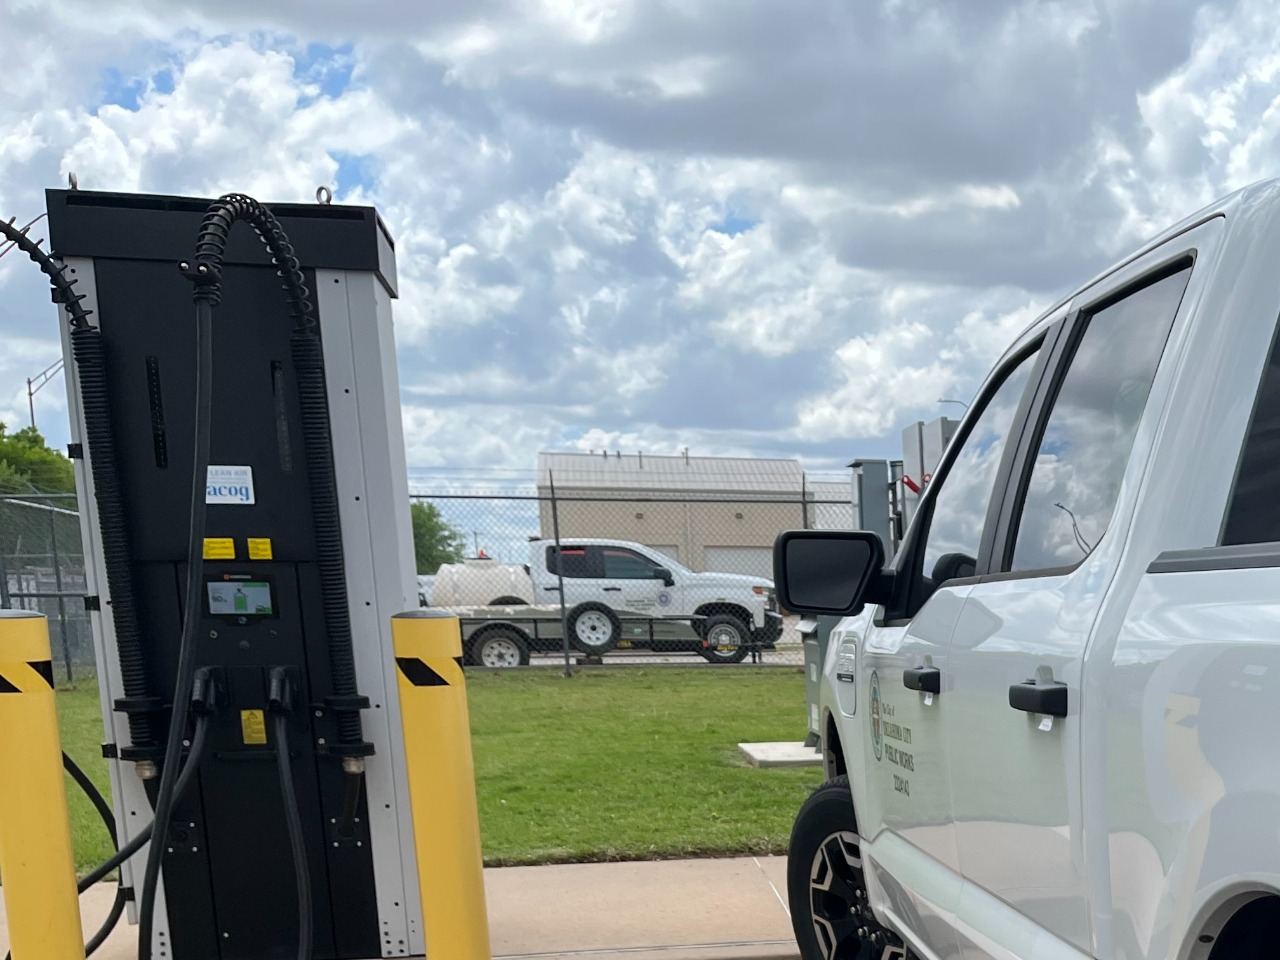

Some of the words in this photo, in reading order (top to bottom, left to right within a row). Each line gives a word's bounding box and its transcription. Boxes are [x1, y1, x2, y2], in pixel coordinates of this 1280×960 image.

[209, 469, 232, 477] LEAN
[207, 485, 250, 501] acog
[899, 750, 914, 772] WORKS
